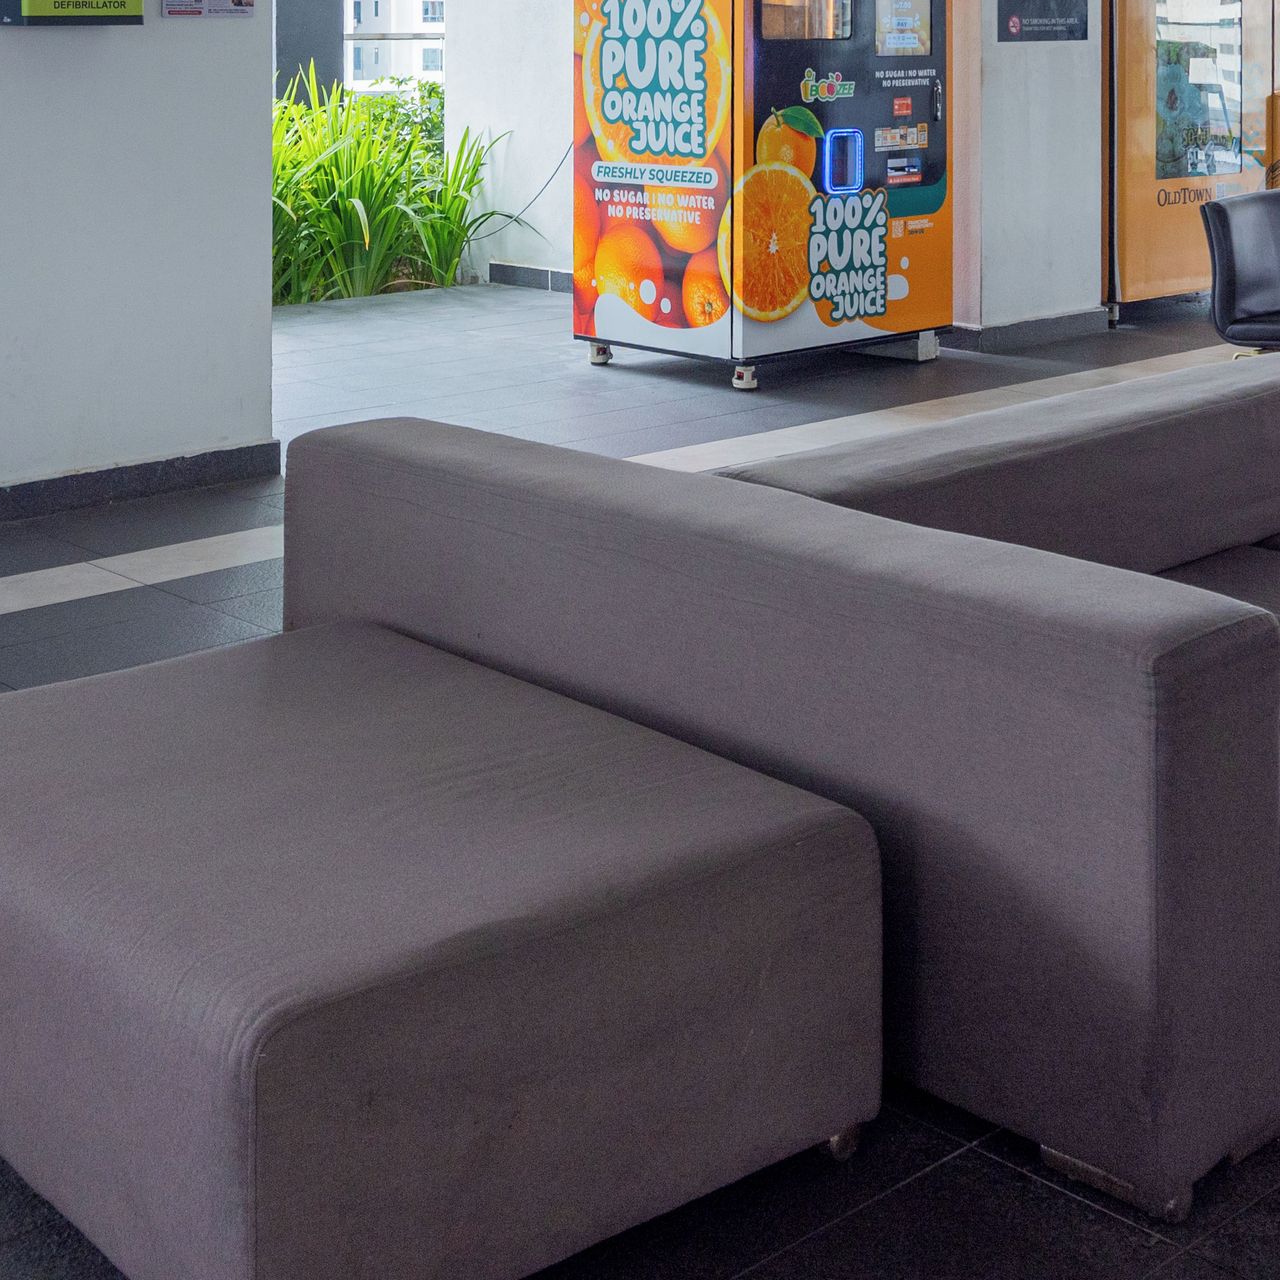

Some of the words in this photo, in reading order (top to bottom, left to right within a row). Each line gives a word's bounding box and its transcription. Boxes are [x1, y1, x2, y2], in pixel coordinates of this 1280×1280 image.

[53, 0, 127, 10] DEFIBRILLATOR
[602, 38, 705, 92] PURE
[875, 70, 885, 78] NO
[885, 70, 905, 78] SUGAR
[908, 69, 917, 77] NO
[918, 68, 936, 76] WATER
[882, 79, 891, 87] NO
[892, 78, 930, 87] PRESERVATIVE
[603, 90, 704, 123] ORANGE
[631, 122, 705, 155] JUICE
[596, 165, 647, 182] FRESHLY
[648, 168, 713, 185] SQUEEZED
[595, 187, 611, 201] NO
[613, 189, 651, 205] SUGAR
[657, 193, 676, 207] NO
[677, 195, 716, 210] WATER
[1157, 187, 1213, 207] OLDTOWN
[608, 204, 624, 218] NO
[625, 205, 701, 225] PRESERVATIVE
[809, 193, 887, 234] 100%
[809, 227, 887, 273] PURE
[810, 267, 885, 299] ORANGE
[831, 290, 885, 320] JUICE
